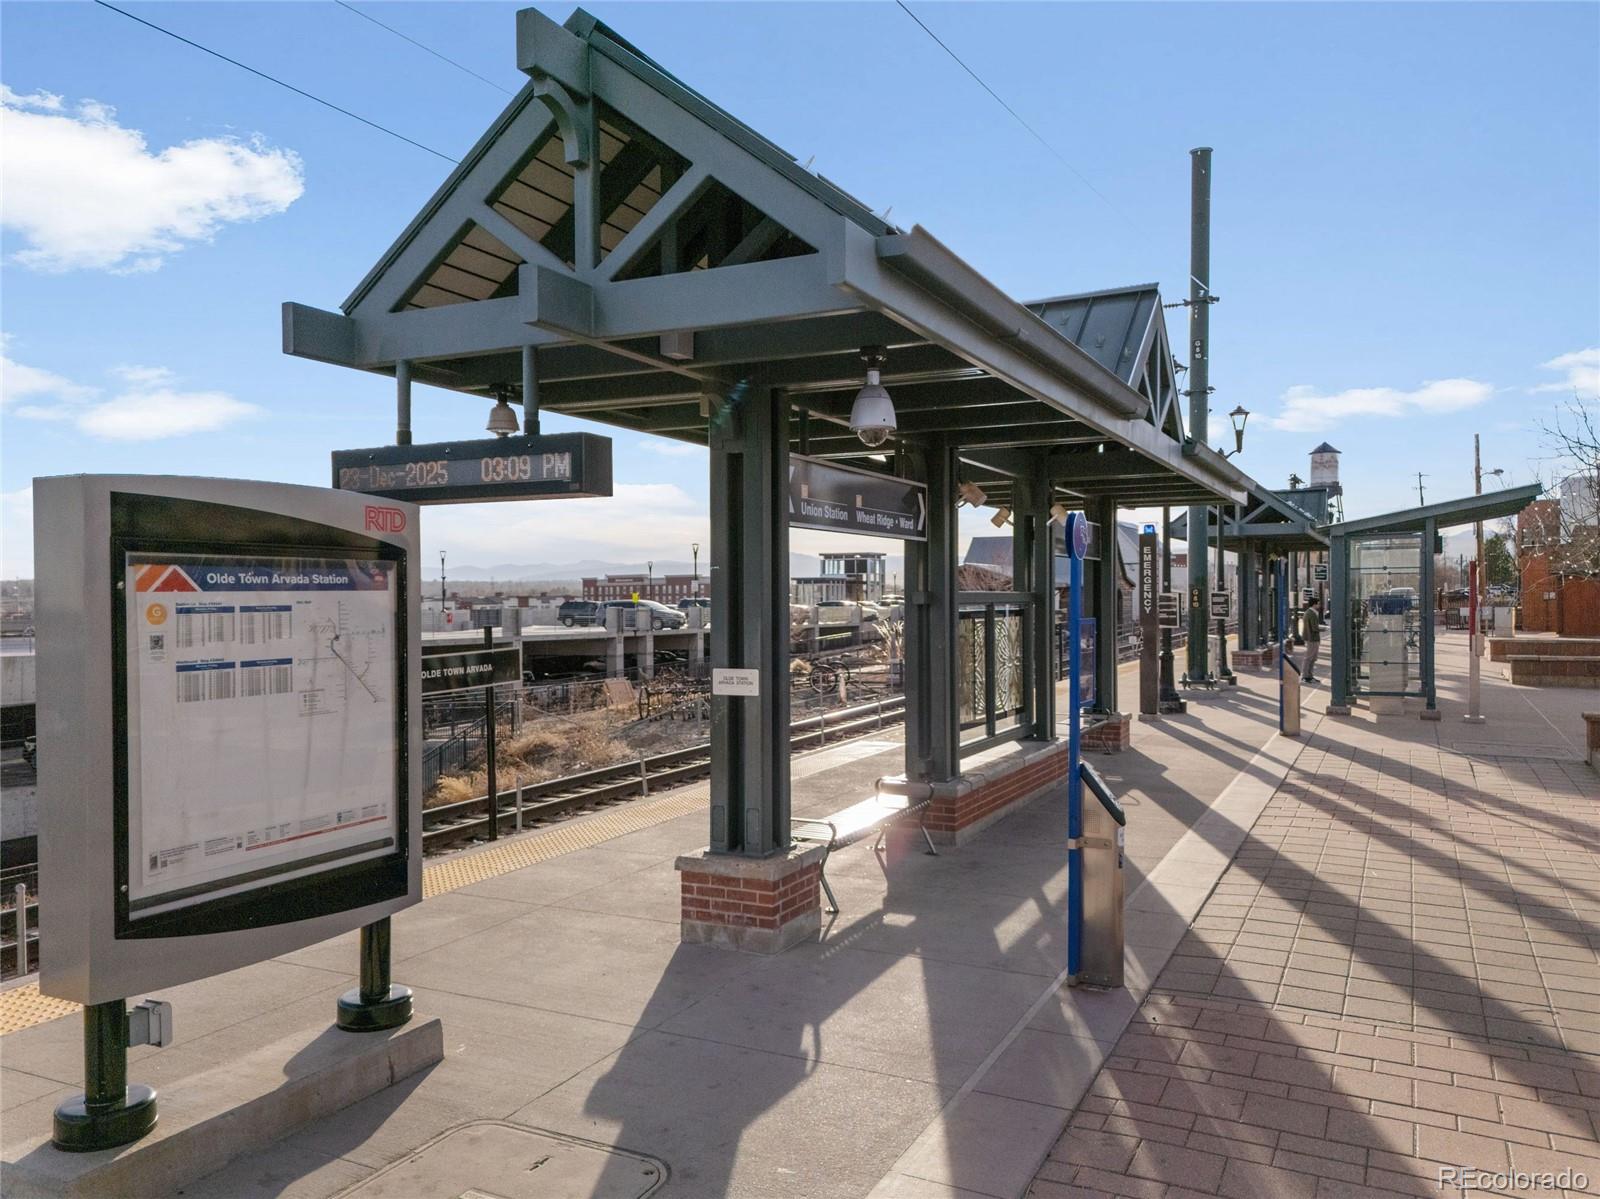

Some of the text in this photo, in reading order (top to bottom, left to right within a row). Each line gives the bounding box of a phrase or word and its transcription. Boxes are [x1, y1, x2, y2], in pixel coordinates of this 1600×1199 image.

[481, 455, 530, 481] 03:09
[543, 452, 570, 478] PM
[365, 505, 406, 532] RTD
[801, 502, 848, 521] Union Station
[856, 511, 914, 530] Wheat Ridge Ward
[206, 573, 349, 585] Olde Town Arvada Station
[1143, 546, 1153, 614] EMERGENCY
[152, 606, 162, 616] G
[421, 664, 493, 679] OLDE TOWN ARVADA
